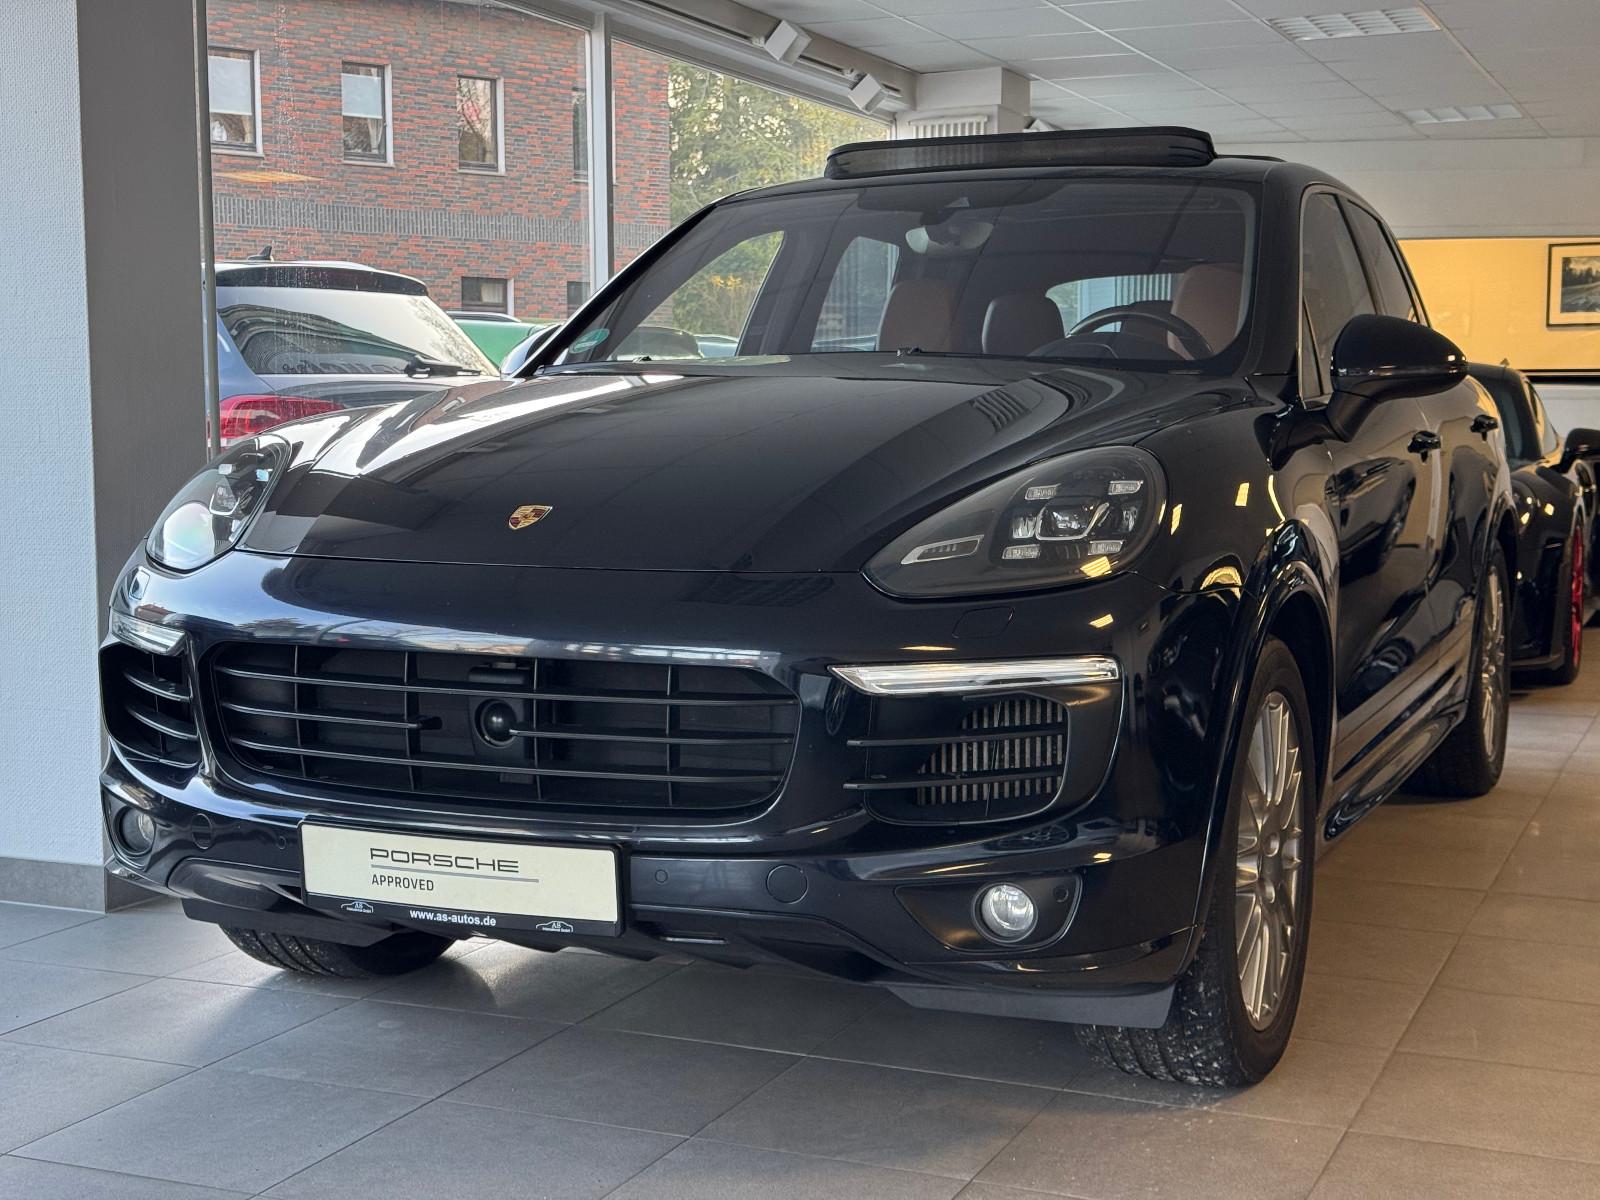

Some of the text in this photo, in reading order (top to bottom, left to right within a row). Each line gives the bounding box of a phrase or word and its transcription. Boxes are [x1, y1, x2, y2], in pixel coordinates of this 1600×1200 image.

[370, 848, 519, 873] PORSCHE
[372, 874, 434, 891] APPROVED
[409, 910, 496, 926] www.as-autos.de
